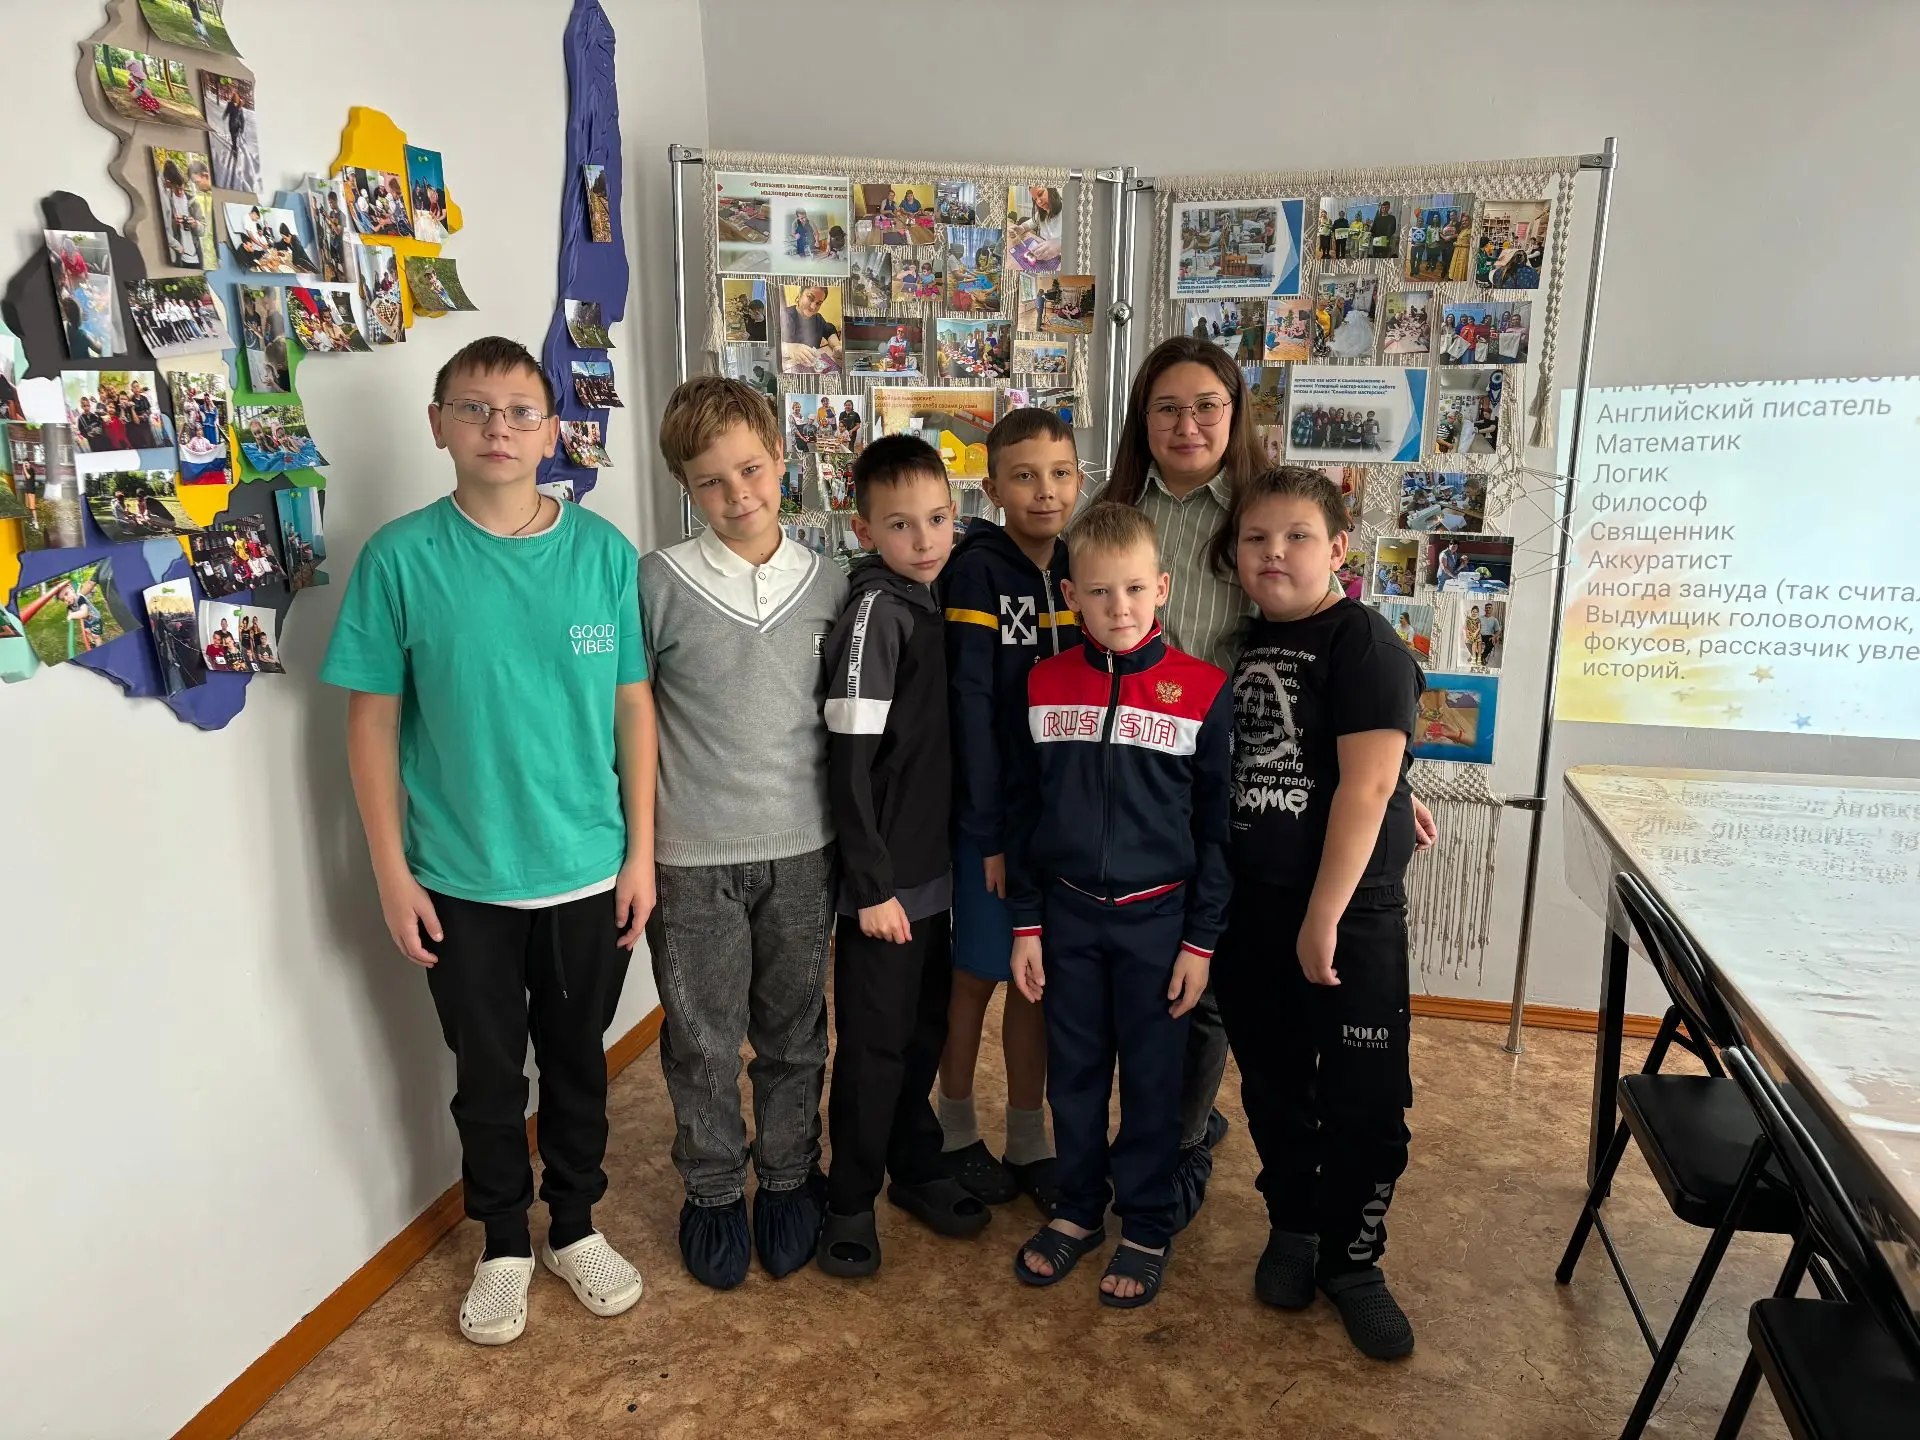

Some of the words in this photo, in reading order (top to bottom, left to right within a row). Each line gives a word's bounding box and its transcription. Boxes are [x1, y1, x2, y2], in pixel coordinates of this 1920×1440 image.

[1596, 397, 1753, 424] Английский
[1762, 397, 1892, 418] писатель
[1596, 433, 1741, 454] Математик
[1592, 463, 1669, 484] Логик
[1592, 490, 1708, 516] Философ
[1590, 521, 1736, 545] Священник
[1587, 550, 1733, 574] Аккуратист
[1587, 581, 1671, 601] иногда
[1679, 582, 1767, 604] зануда
[1776, 577, 1830, 604] (так
[1838, 584, 1920, 602] счита
[1586, 604, 1721, 629] Выдумщик
[1729, 611, 1913, 635] головоломок,
[569, 624, 615, 639] GOOD
[571, 638, 614, 655] VIBES
[1280, 648, 1296, 657] run
[1296, 650, 1317, 662] free
[1584, 631, 1691, 656] фокусов,
[1699, 638, 1850, 658] рассказчик
[1857, 643, 1920, 664] увле
[1276, 660, 1298, 673] don't
[1583, 660, 1685, 682] историй.
[1250, 772, 1277, 787] Keep
[1279, 775, 1316, 790] ready.
[1342, 1024, 1389, 1041] POLO
[1366, 1041, 1389, 1049] STYLE
